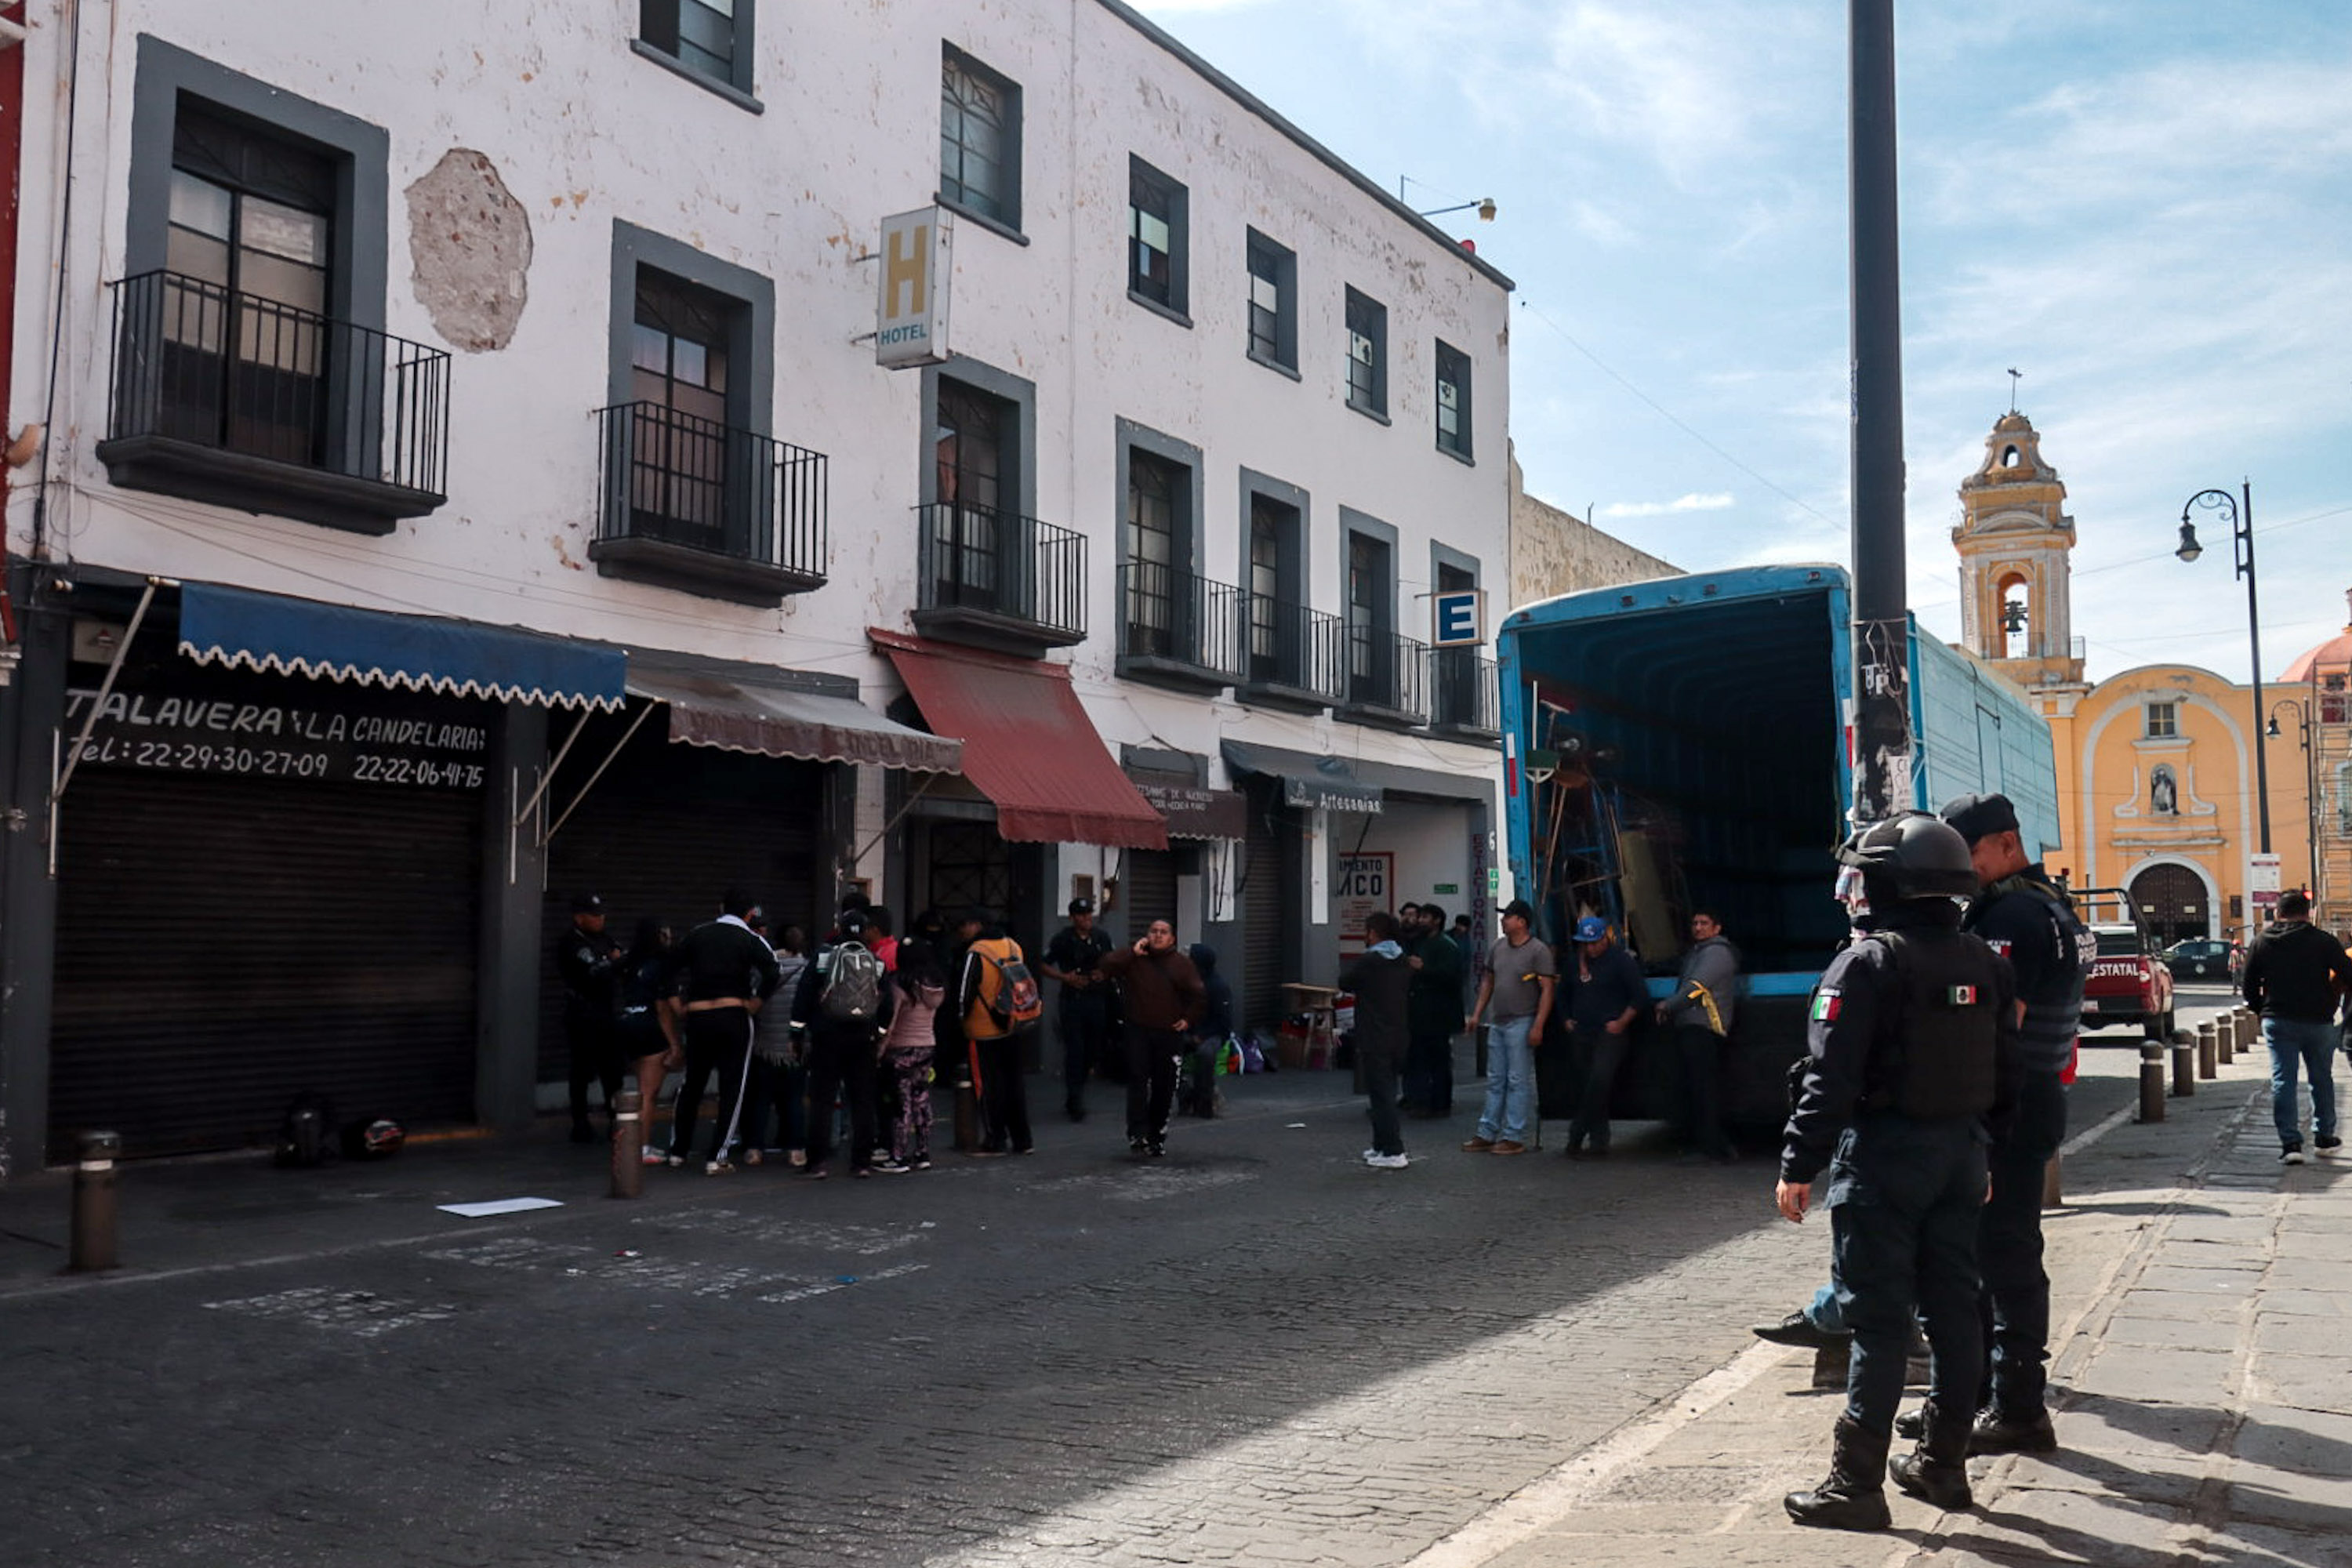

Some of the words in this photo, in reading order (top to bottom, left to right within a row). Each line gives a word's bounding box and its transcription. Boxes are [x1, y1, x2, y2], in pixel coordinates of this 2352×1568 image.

[886, 224, 928, 320] H
[880, 323, 927, 346] HOTEL
[1439, 595, 1475, 641] E
[66, 688, 284, 735] TALAVERA
[2092, 963, 2139, 977] ESTATAL
